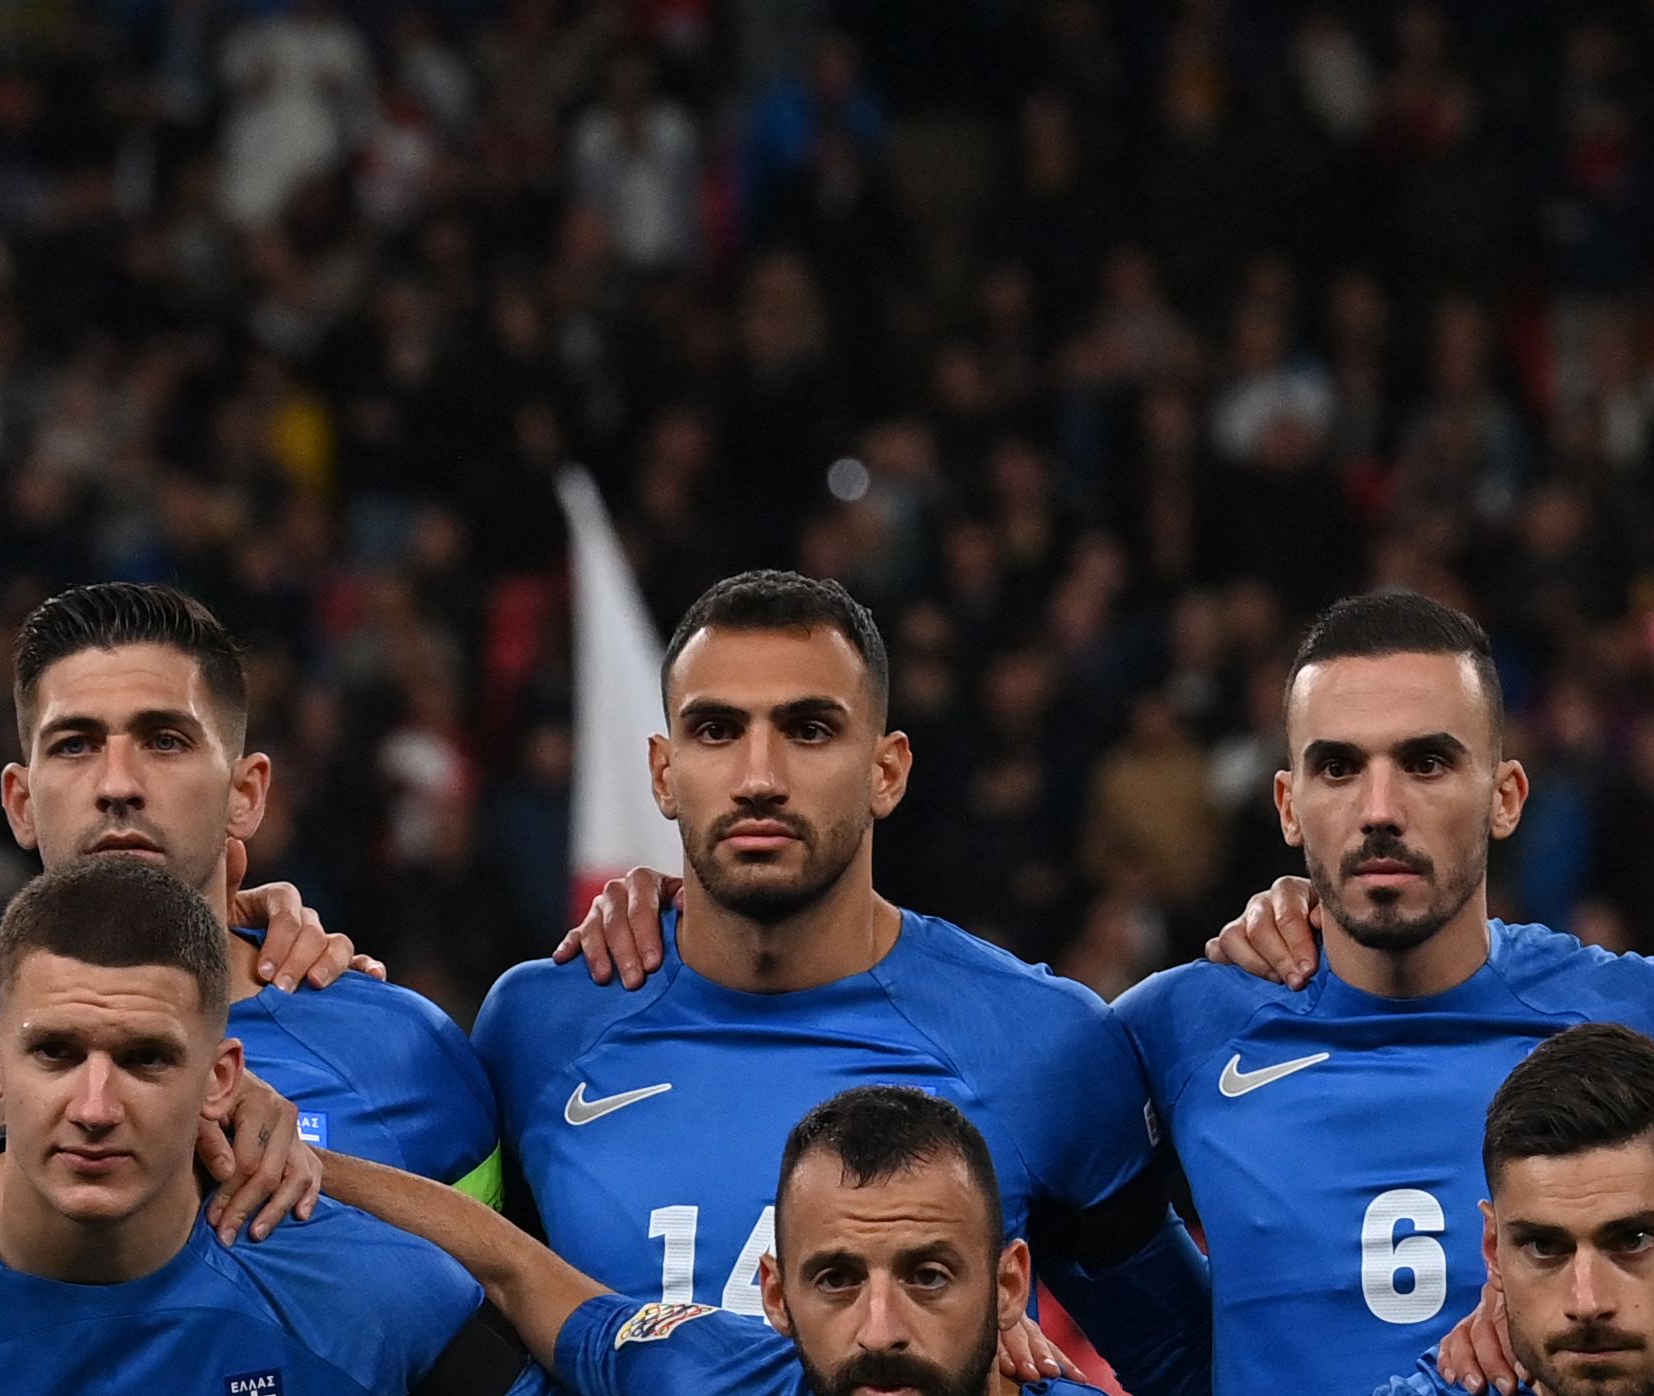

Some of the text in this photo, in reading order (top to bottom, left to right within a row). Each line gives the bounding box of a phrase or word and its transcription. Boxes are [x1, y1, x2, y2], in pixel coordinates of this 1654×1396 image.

[648, 1205, 778, 1326] 14
[1361, 1188, 1447, 1324] 6
[230, 1375, 276, 1394] ΕΛΛΑΣ
